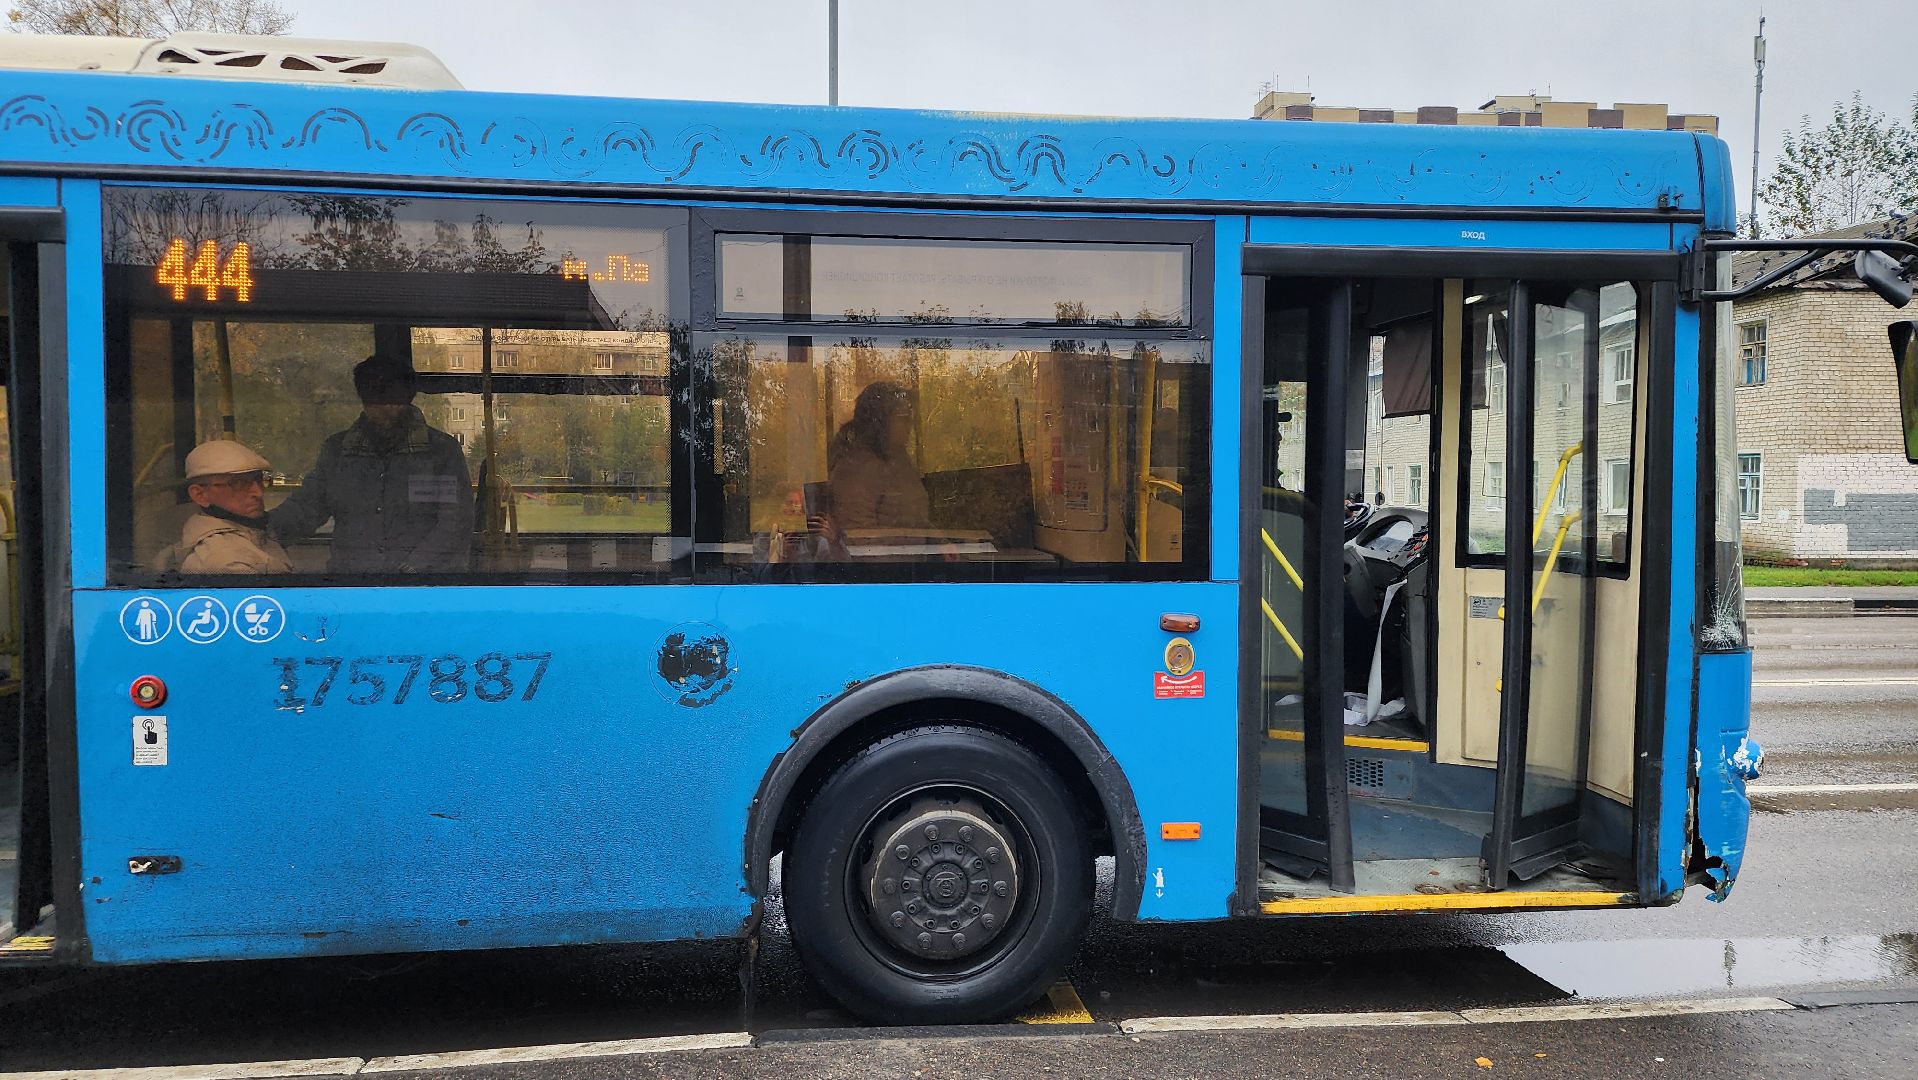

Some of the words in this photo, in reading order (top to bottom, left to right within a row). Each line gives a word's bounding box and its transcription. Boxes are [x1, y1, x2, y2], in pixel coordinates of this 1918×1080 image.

[1461, 230, 1486, 241] ВХОД
[158, 239, 253, 302] 444
[273, 651, 552, 707] 1757887
